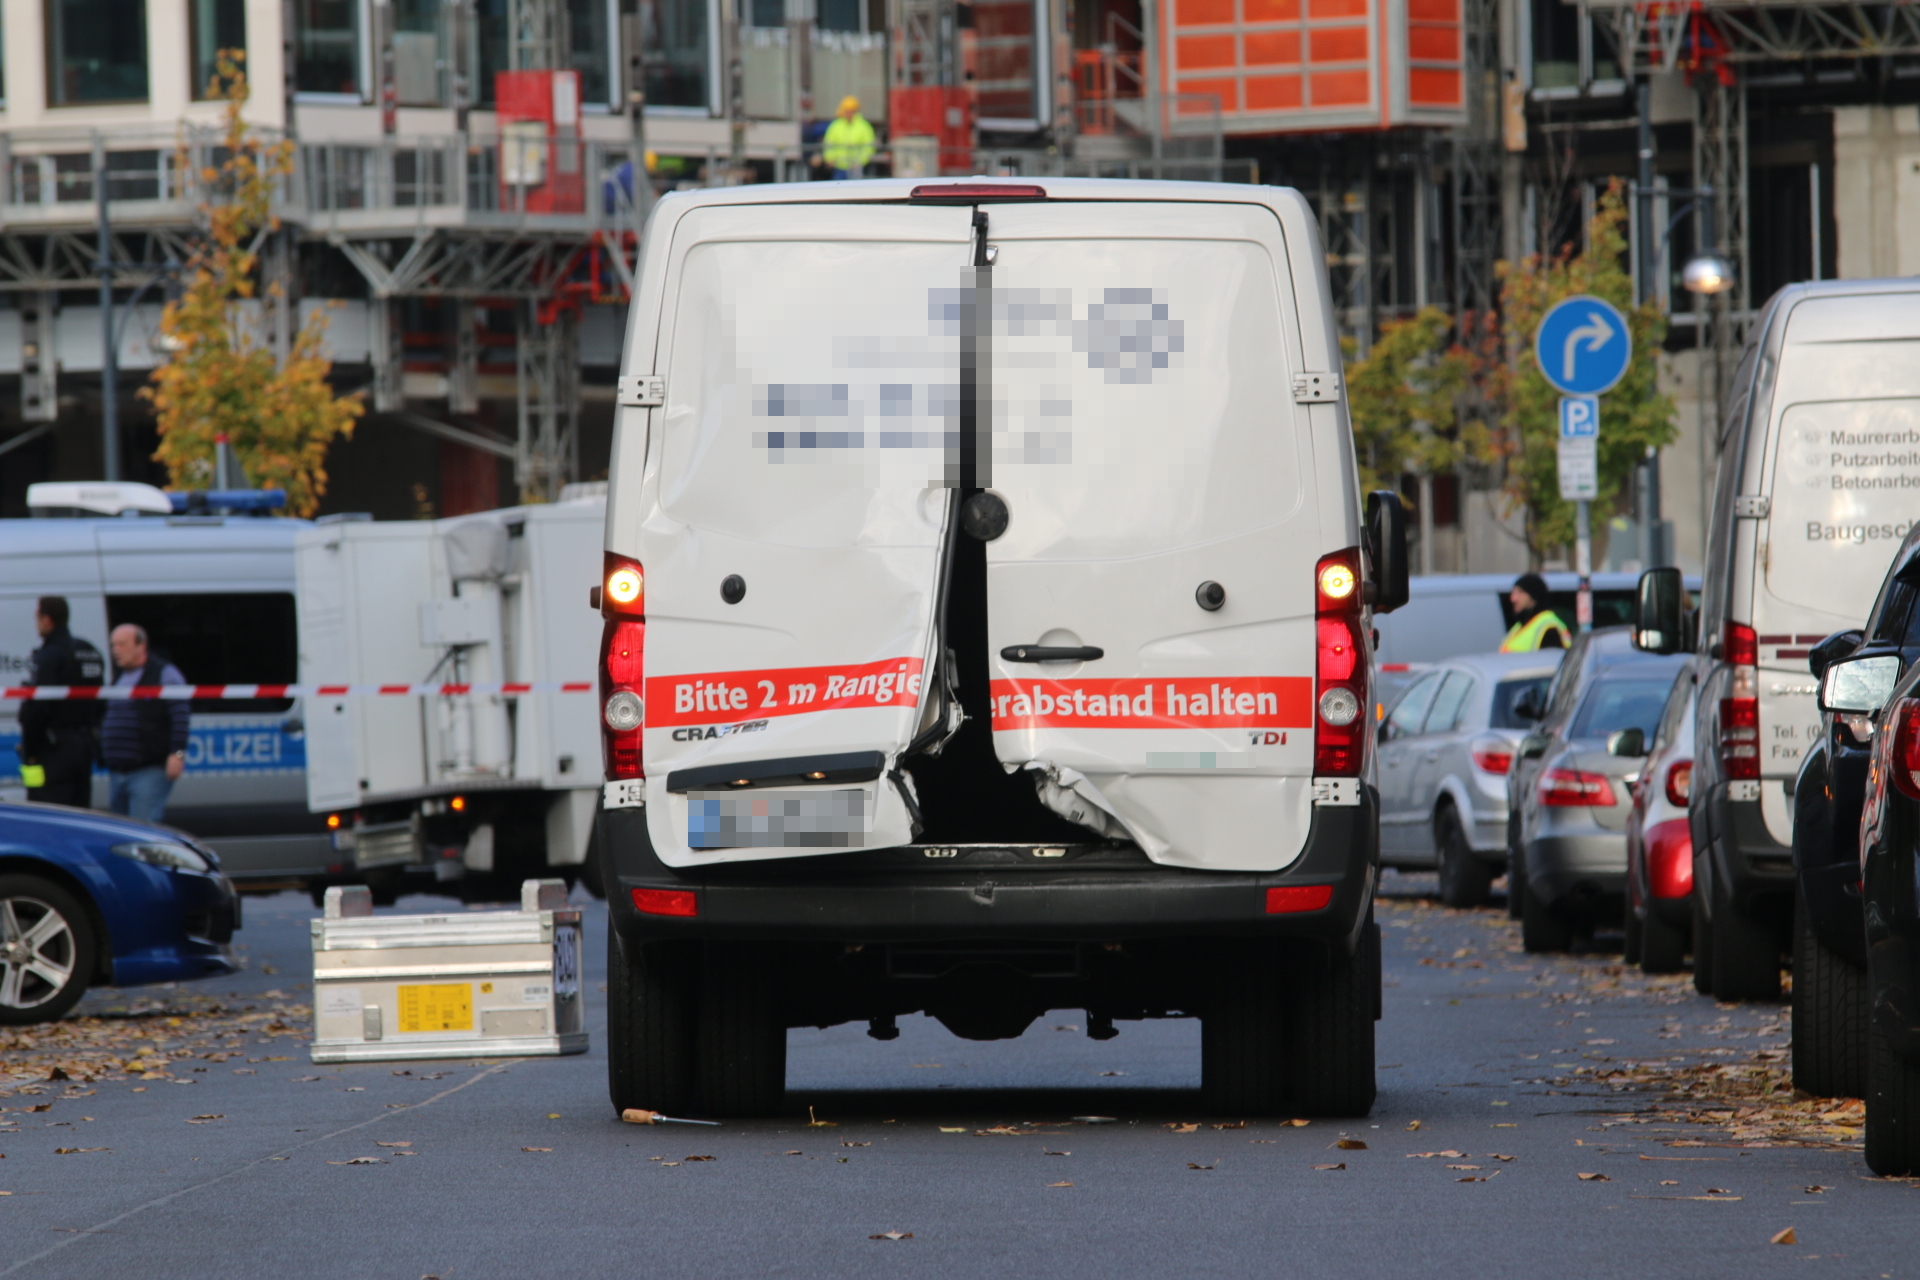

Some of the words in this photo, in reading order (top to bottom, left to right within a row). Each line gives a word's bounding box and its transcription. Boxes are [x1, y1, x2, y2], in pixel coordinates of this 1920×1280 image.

[1567, 401, 1590, 434] P
[674, 680, 749, 714] Bitte
[757, 680, 778, 708] 2
[788, 682, 817, 706] m
[1166, 683, 1278, 716] halten
[671, 719, 769, 742] CRAFTER
[1248, 731, 1288, 746] TDI
[1772, 744, 1799, 758] Fax
